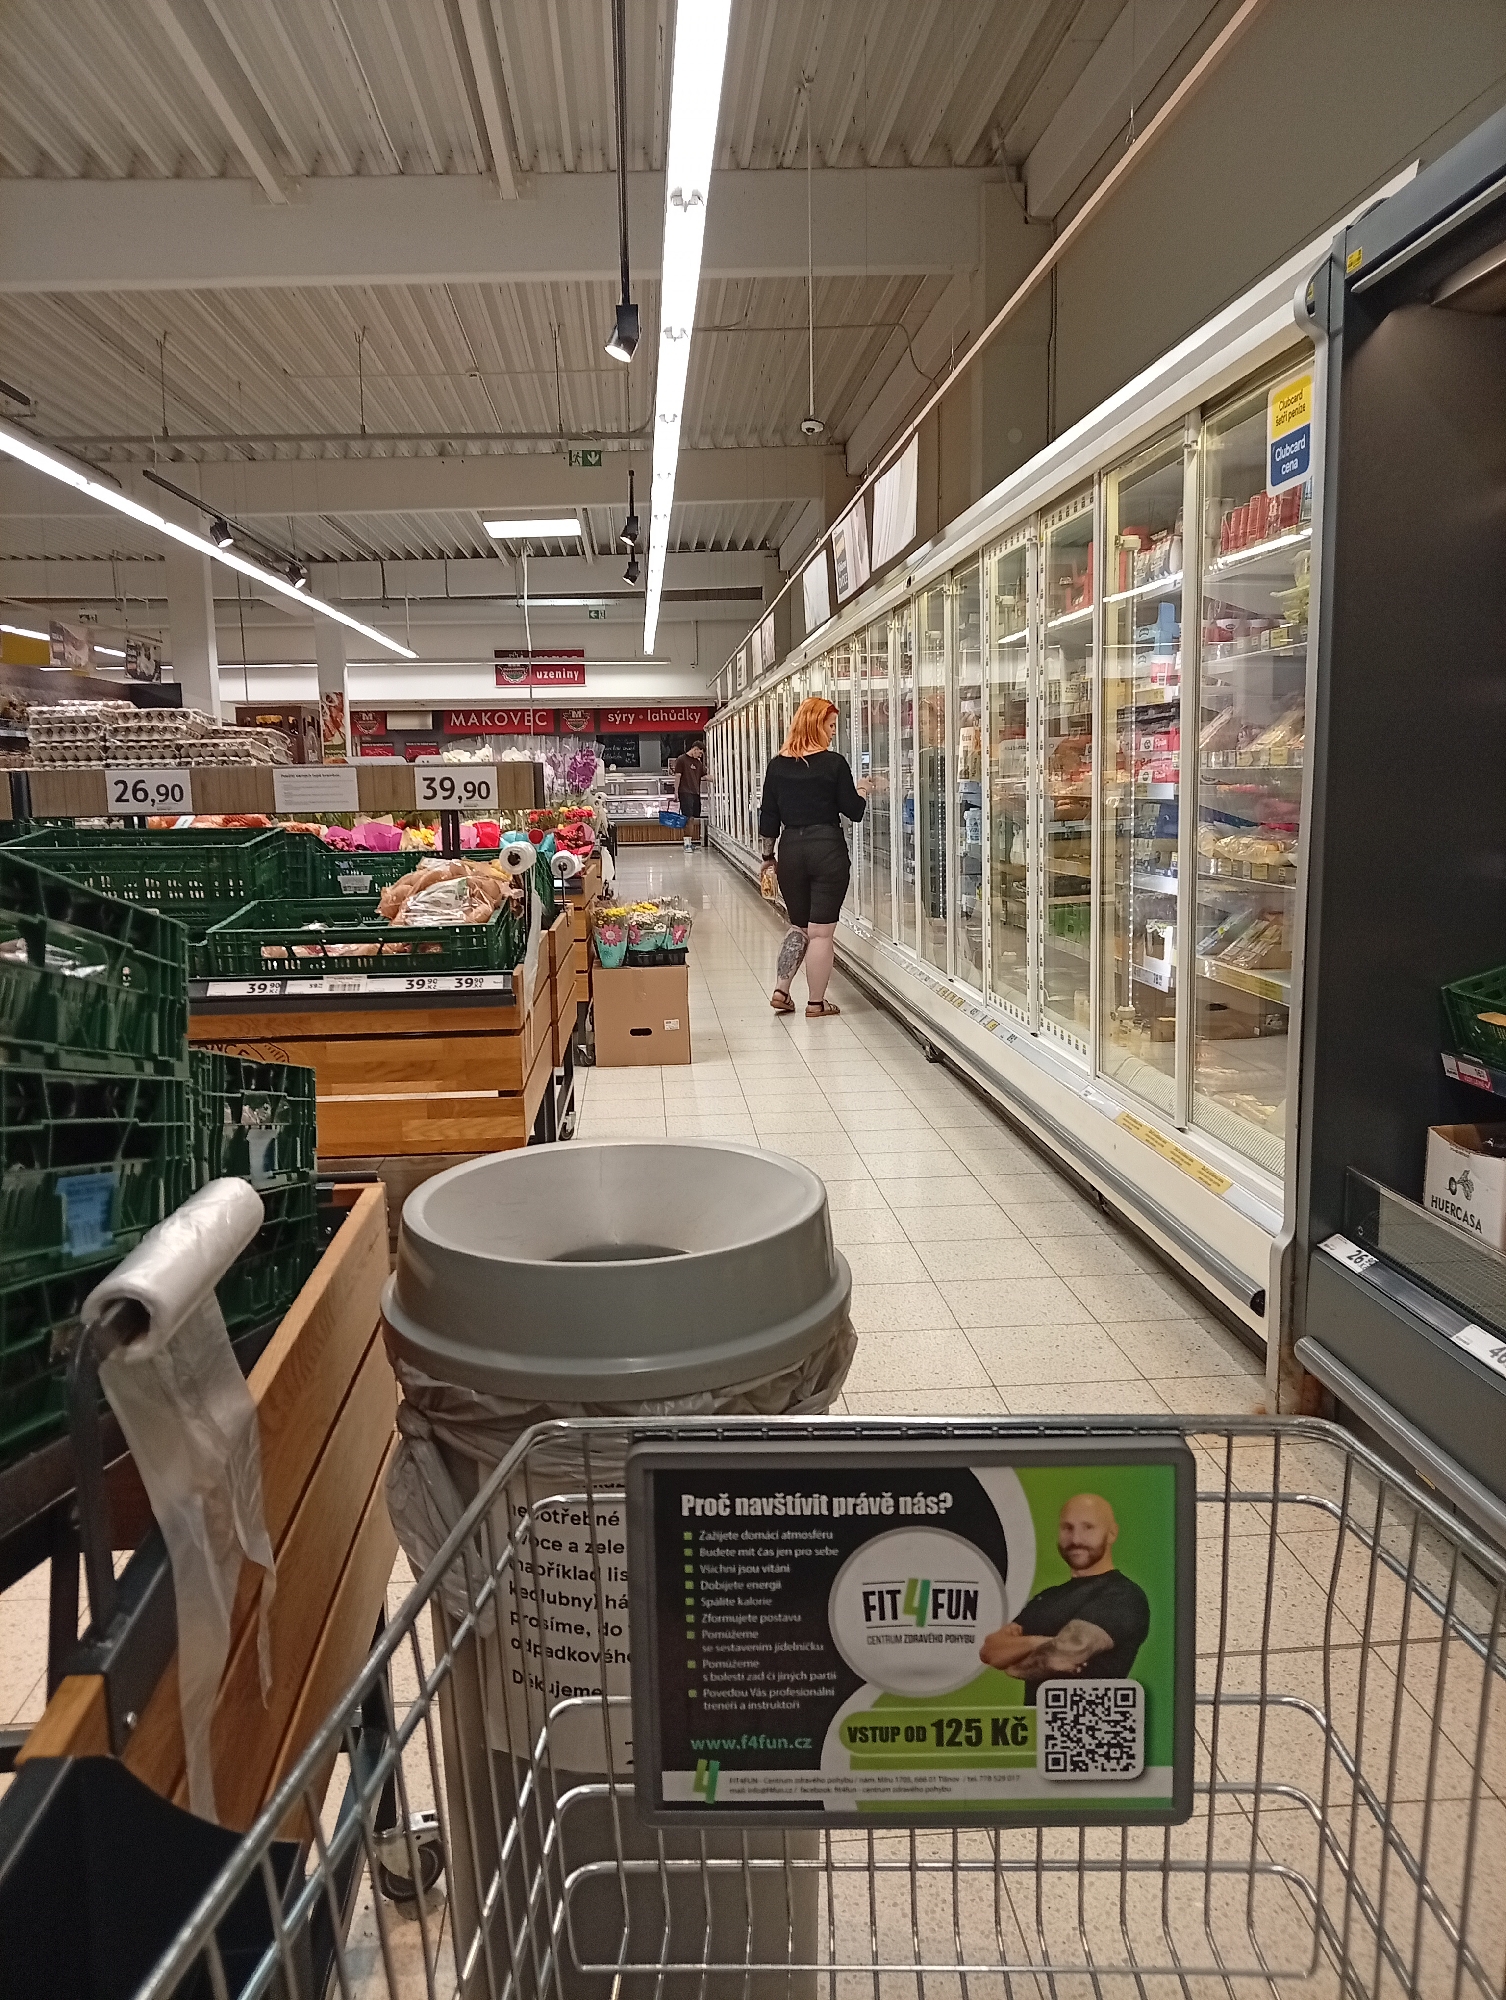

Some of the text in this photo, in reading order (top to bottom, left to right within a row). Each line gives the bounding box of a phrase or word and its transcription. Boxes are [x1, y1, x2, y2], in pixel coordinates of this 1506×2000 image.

[1279, 388, 1304, 412] Clubcard
[1274, 434, 1306, 462] Clubcard
[1281, 458, 1298, 475] cena
[536, 668, 579, 681] uzeniny
[450, 711, 548, 727] MAKOVEC
[607, 708, 701, 725] sýry lahůdky
[113, 779, 185, 807] 26,90
[421, 776, 491, 804] 39,90
[246, 983, 268, 994] 39
[405, 979, 426, 990] 39
[454, 978, 474, 988] 39
[1431, 1195, 1482, 1234] HUERCASA
[1346, 1250, 1368, 1264] 26
[681, 1491, 954, 1518] Proč navštívit právě nás?
[512, 1504, 620, 1526] eotřebné
[699, 1548, 737, 1558] Budete
[756, 1548, 774, 1557] čas
[776, 1548, 793, 1558] jen
[794, 1549, 812, 1558] pro
[814, 1546, 840, 1556] sebe
[738, 1564, 760, 1575] jsou
[737, 1596, 773, 1606] kalorie
[701, 1613, 802, 1624] Zformujete postavu
[866, 1632, 976, 1645] CENTRUM ZDRAVÉHO POHYBU
[746, 1671, 764, 1682] zad
[702, 1688, 748, 1698] Povedou
[749, 1687, 767, 1698] Vás
[739, 1702, 746, 1710] a
[847, 1716, 1029, 1748] VSTUP OD 125 Kč
[690, 1734, 812, 1750] www.f4fun.cz
